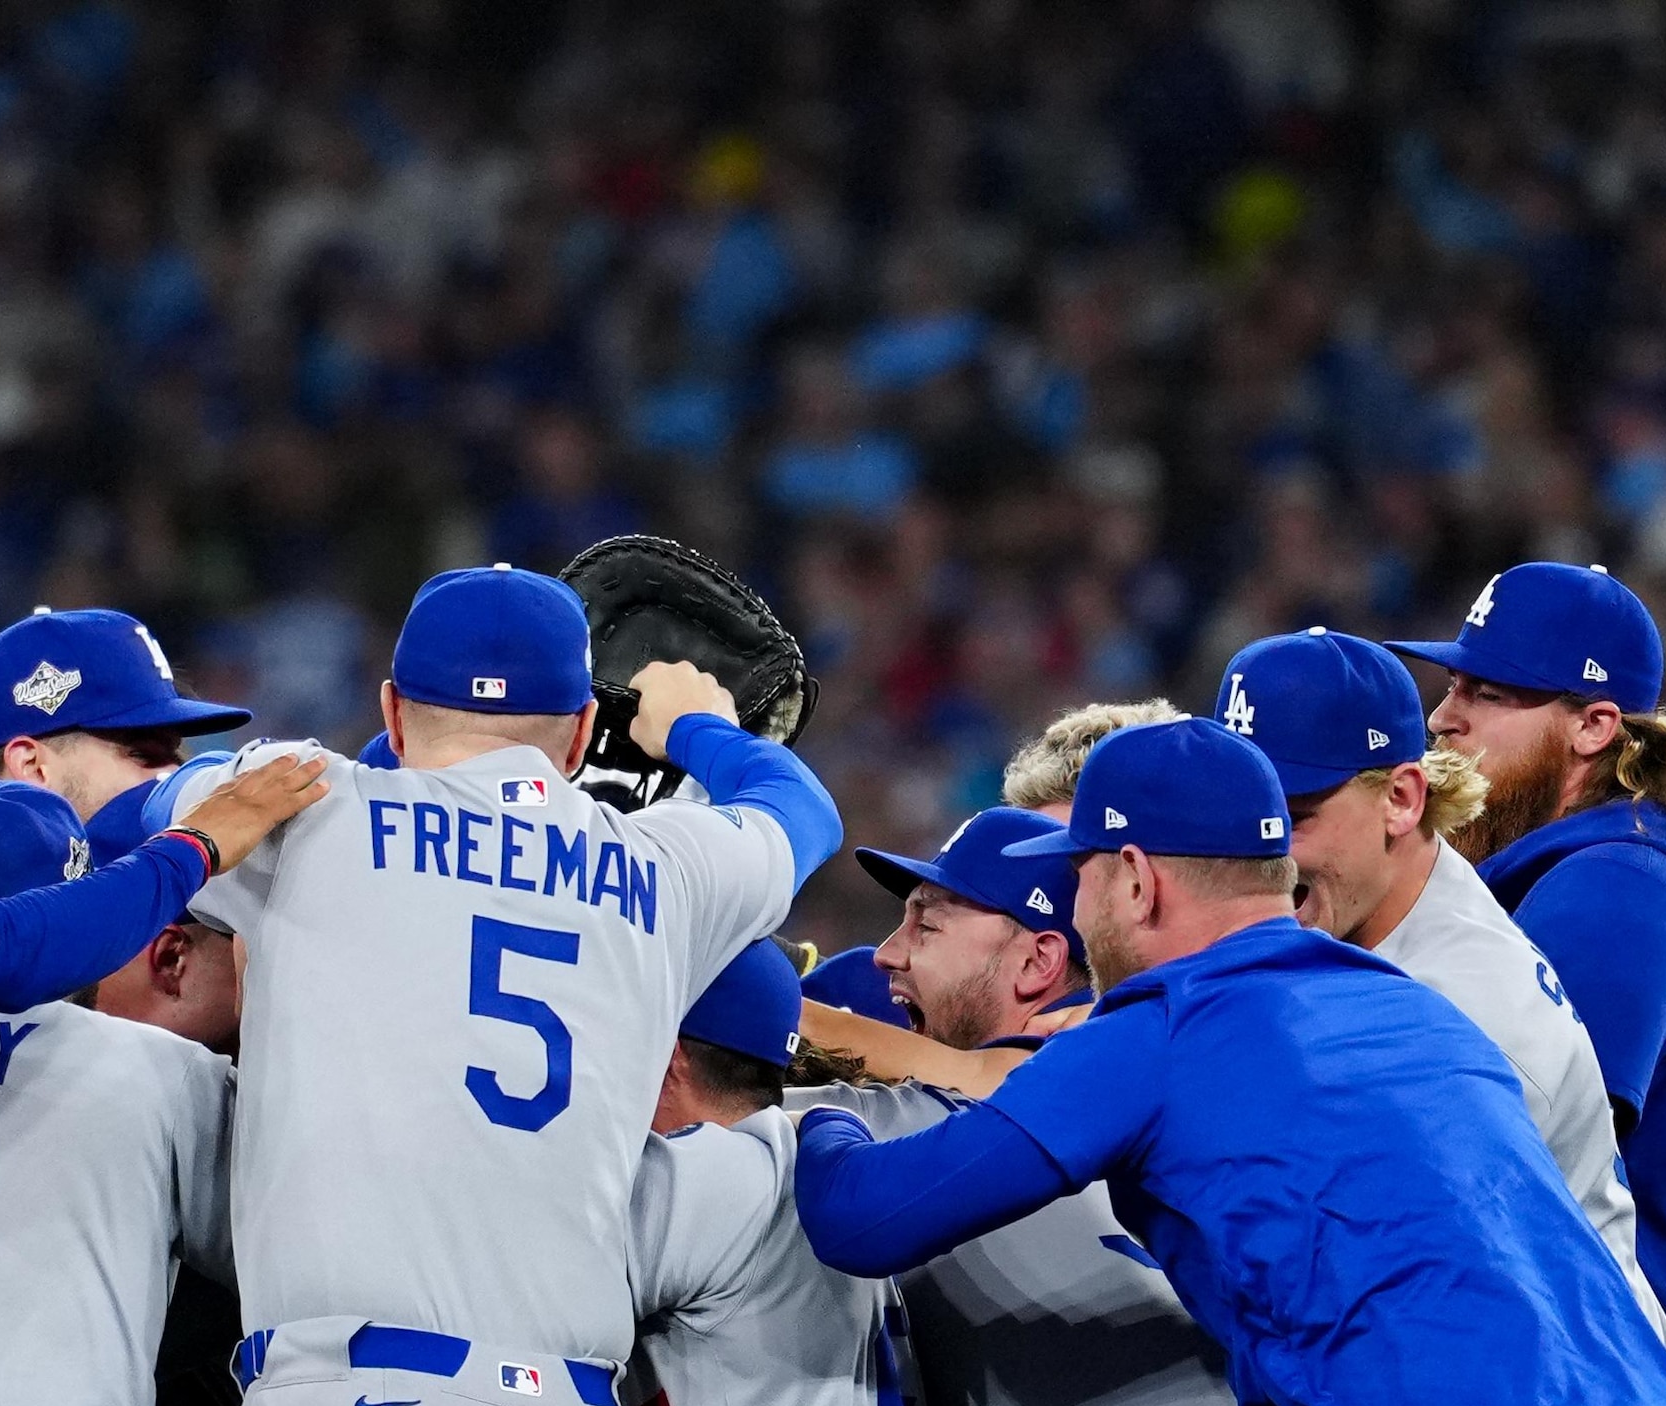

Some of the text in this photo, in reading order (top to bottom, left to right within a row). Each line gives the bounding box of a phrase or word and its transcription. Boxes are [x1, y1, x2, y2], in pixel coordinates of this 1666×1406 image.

[16, 680, 52, 702] World
[1224, 674, 1255, 735] LA
[368, 799, 657, 935] FREEMAN
[465, 914, 580, 1132] 5
